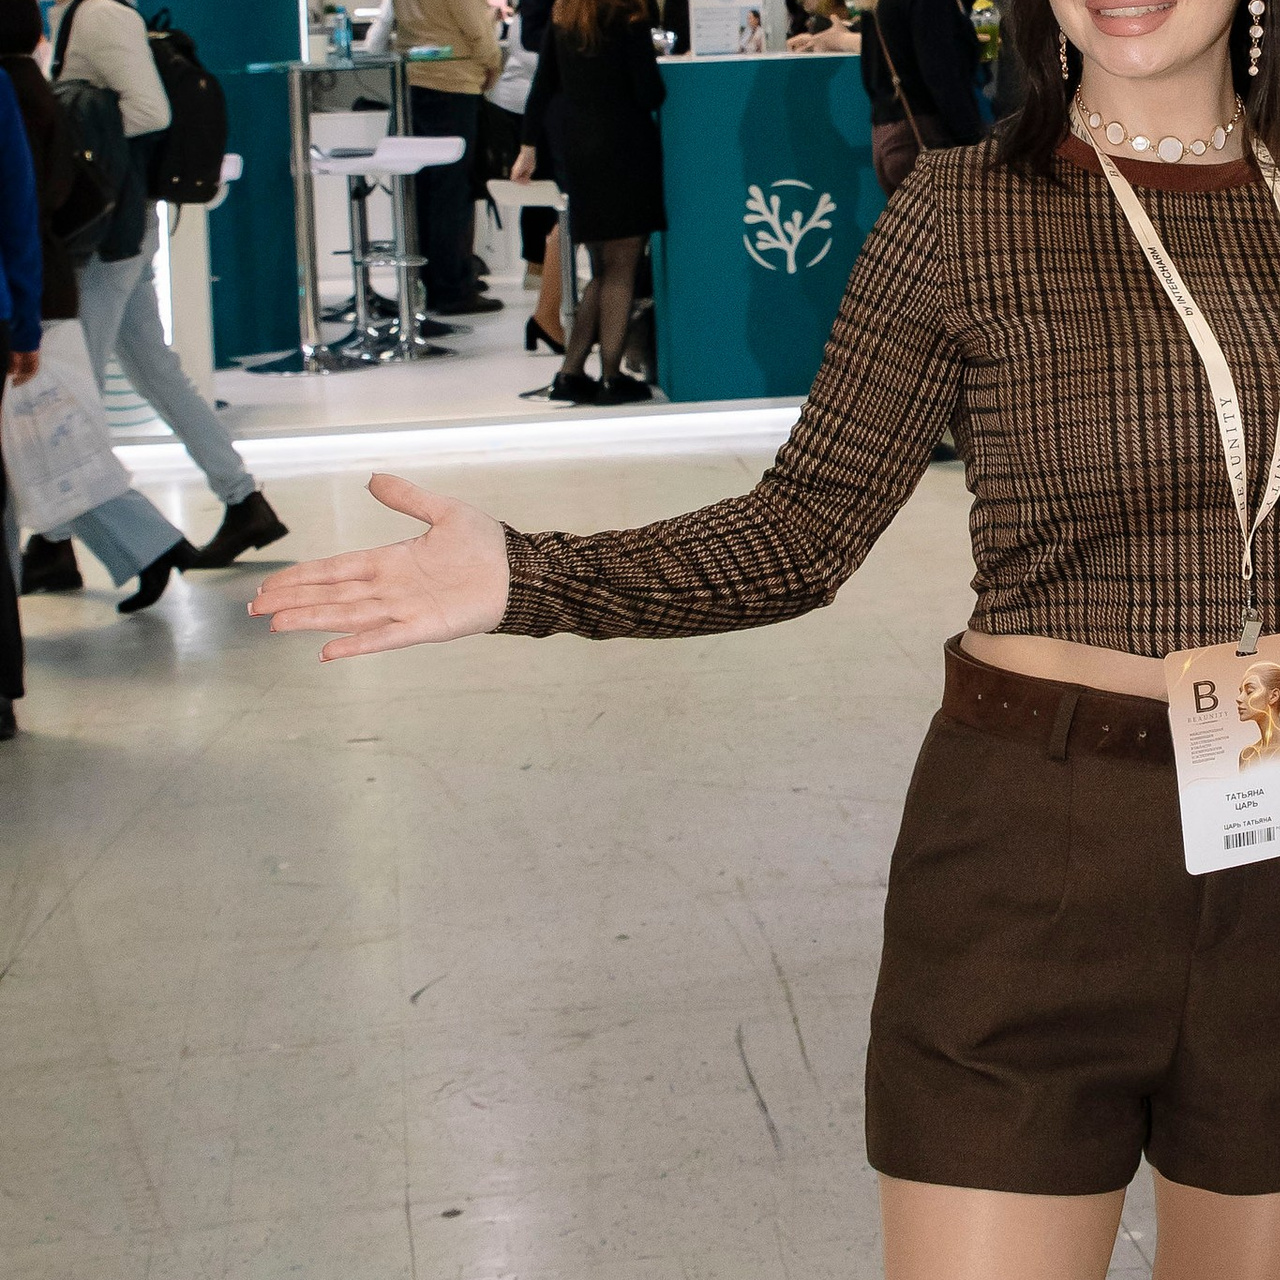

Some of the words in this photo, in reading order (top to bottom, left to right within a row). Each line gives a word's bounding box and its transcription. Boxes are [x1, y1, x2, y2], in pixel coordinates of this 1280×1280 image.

[1147, 246, 1187, 305] INTERCHARM
[1183, 305, 1194, 317] by
[1219, 397, 1246, 512] BEAUNITY
[1192, 680, 1220, 714] B
[1225, 788, 1264, 802] ТАТЬЯНА
[1235, 800, 1259, 811] ЦАРЬ
[1223, 823, 1242, 831] ЦАРЬ
[1242, 816, 1273, 827] ТАТЬЯНА
